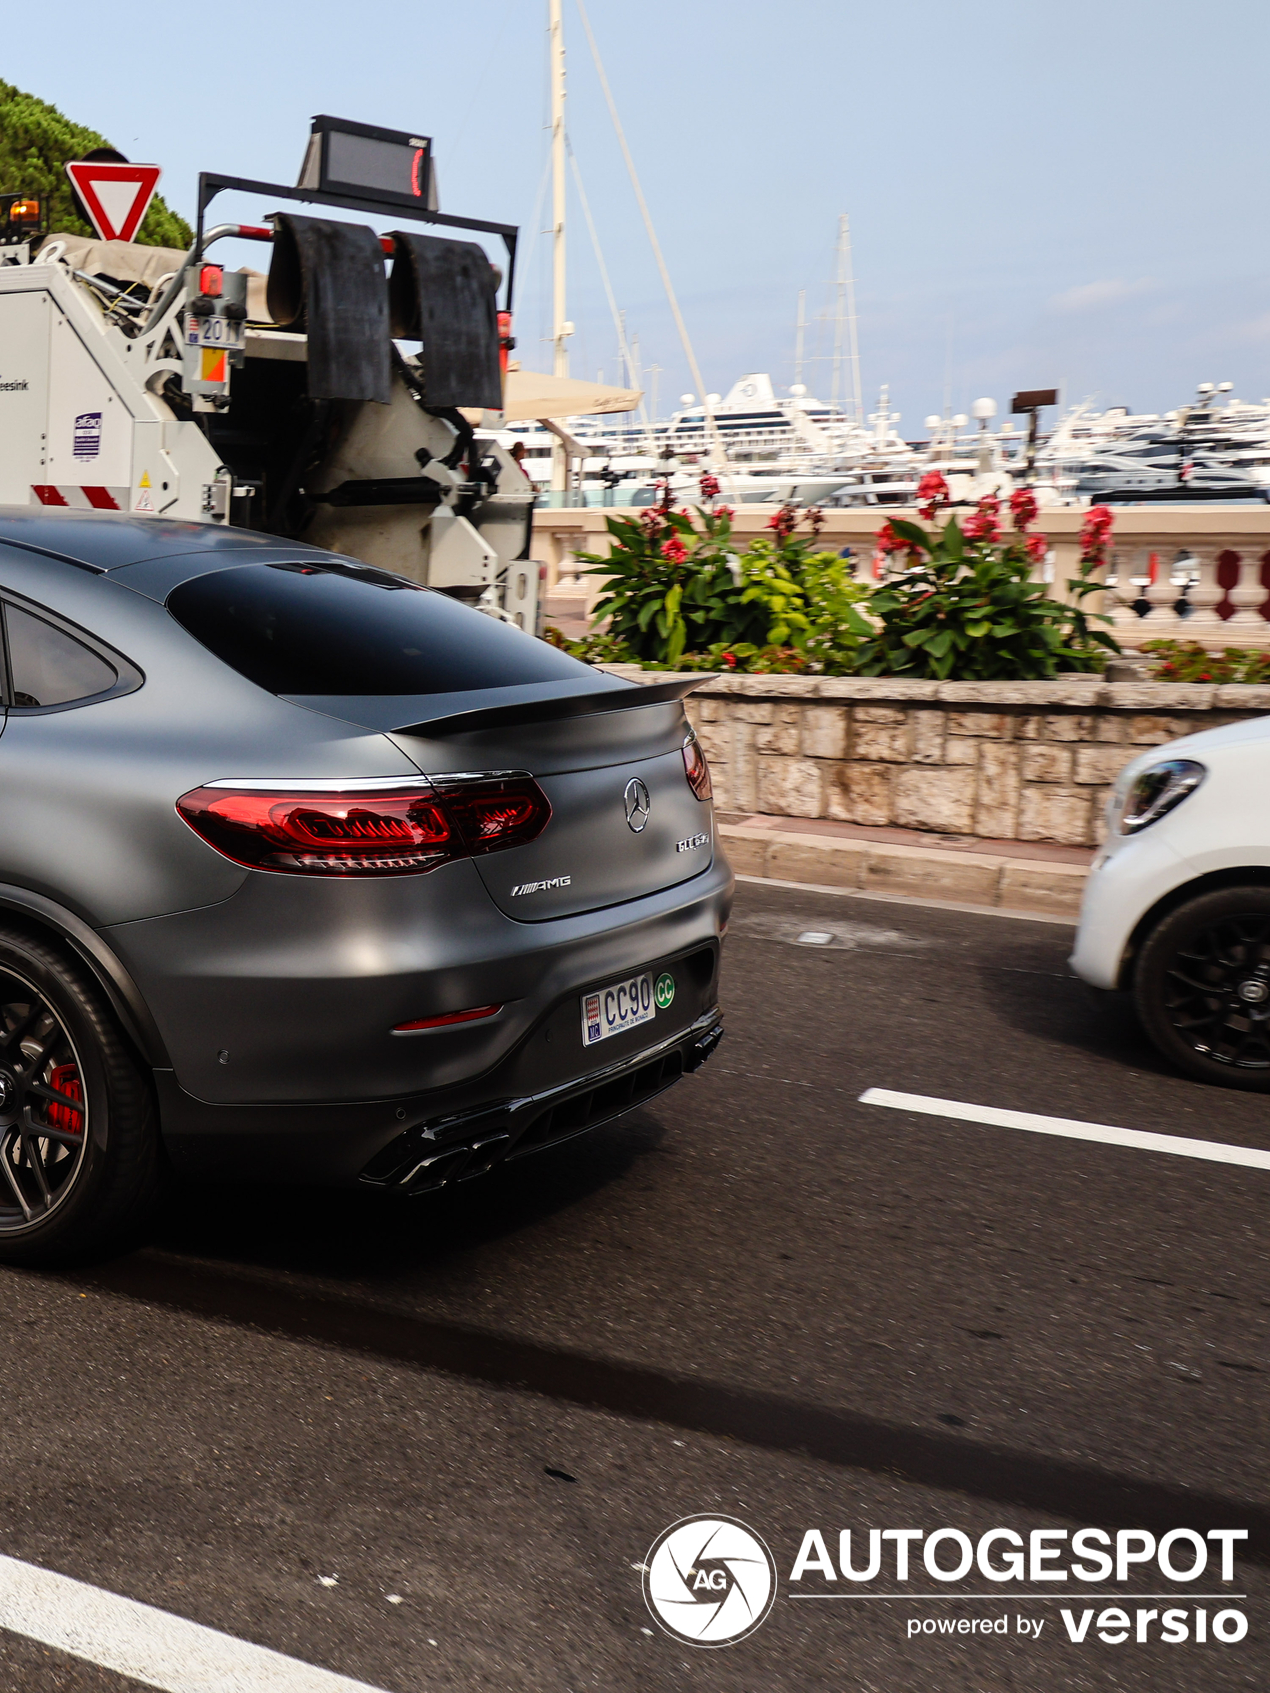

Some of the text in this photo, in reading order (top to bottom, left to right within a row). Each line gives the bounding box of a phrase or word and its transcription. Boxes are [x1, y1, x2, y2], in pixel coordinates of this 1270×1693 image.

[605, 976, 650, 1025] CC90
[657, 979, 672, 1002] CC
[589, 1025, 599, 1038] MC
